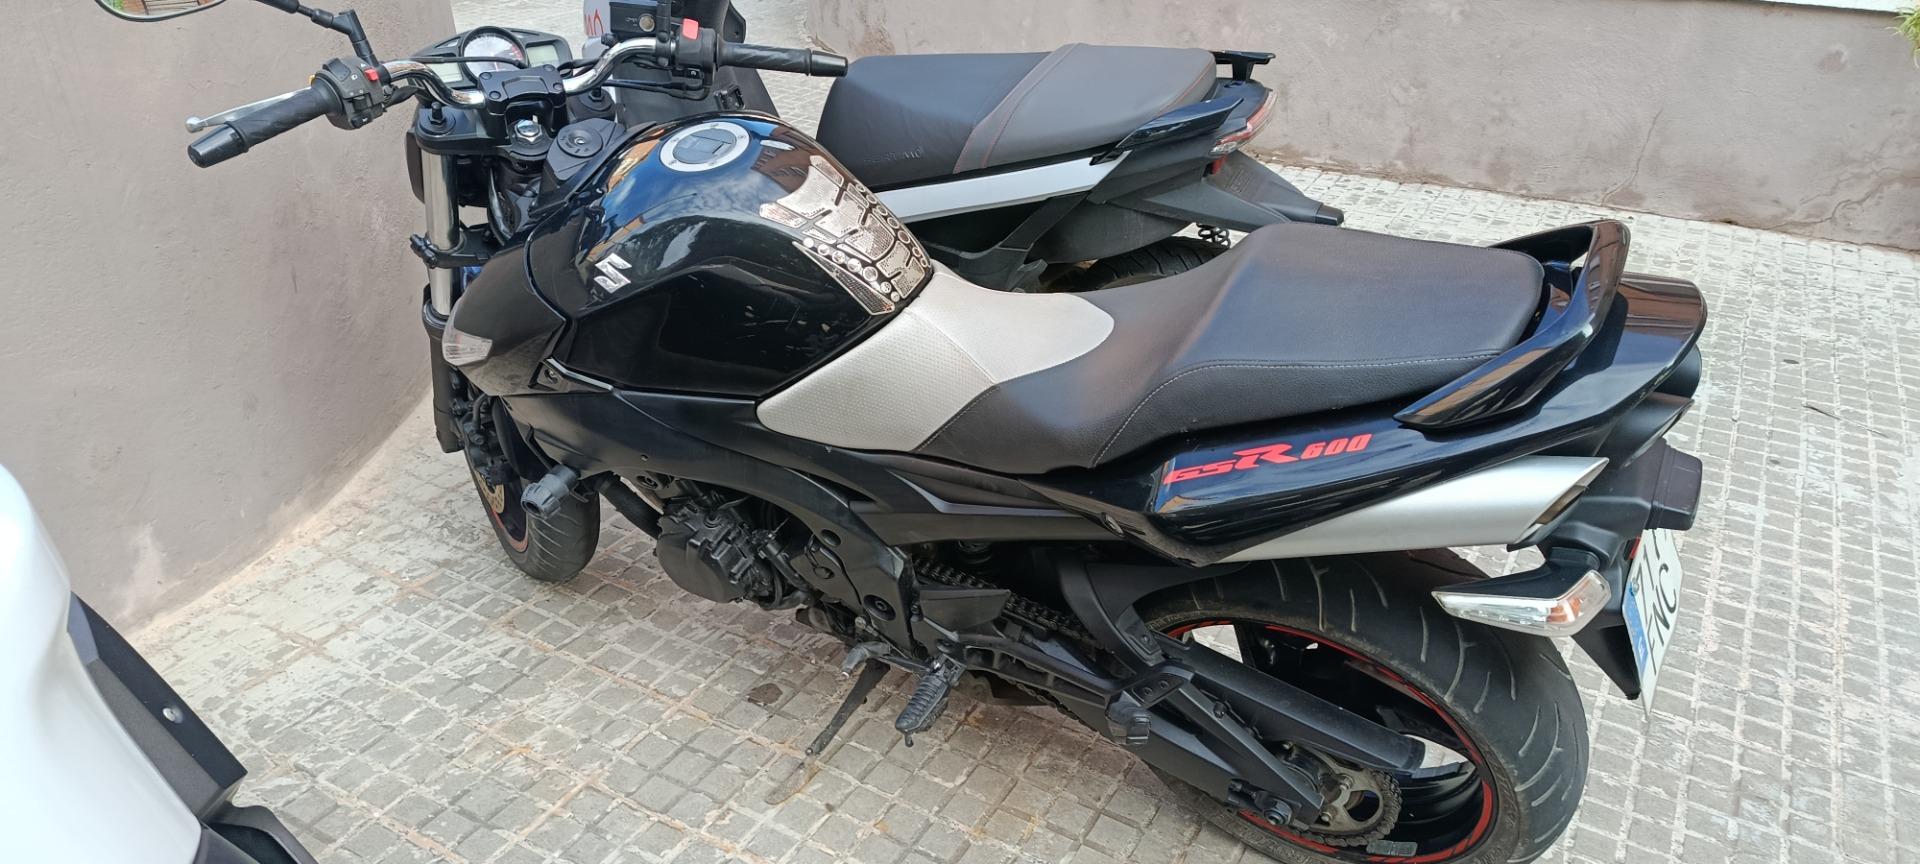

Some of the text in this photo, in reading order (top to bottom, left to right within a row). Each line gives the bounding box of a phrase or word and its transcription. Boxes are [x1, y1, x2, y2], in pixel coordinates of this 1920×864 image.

[1163, 433, 1372, 485] GSR 600
[1647, 562, 1677, 676] FNC
